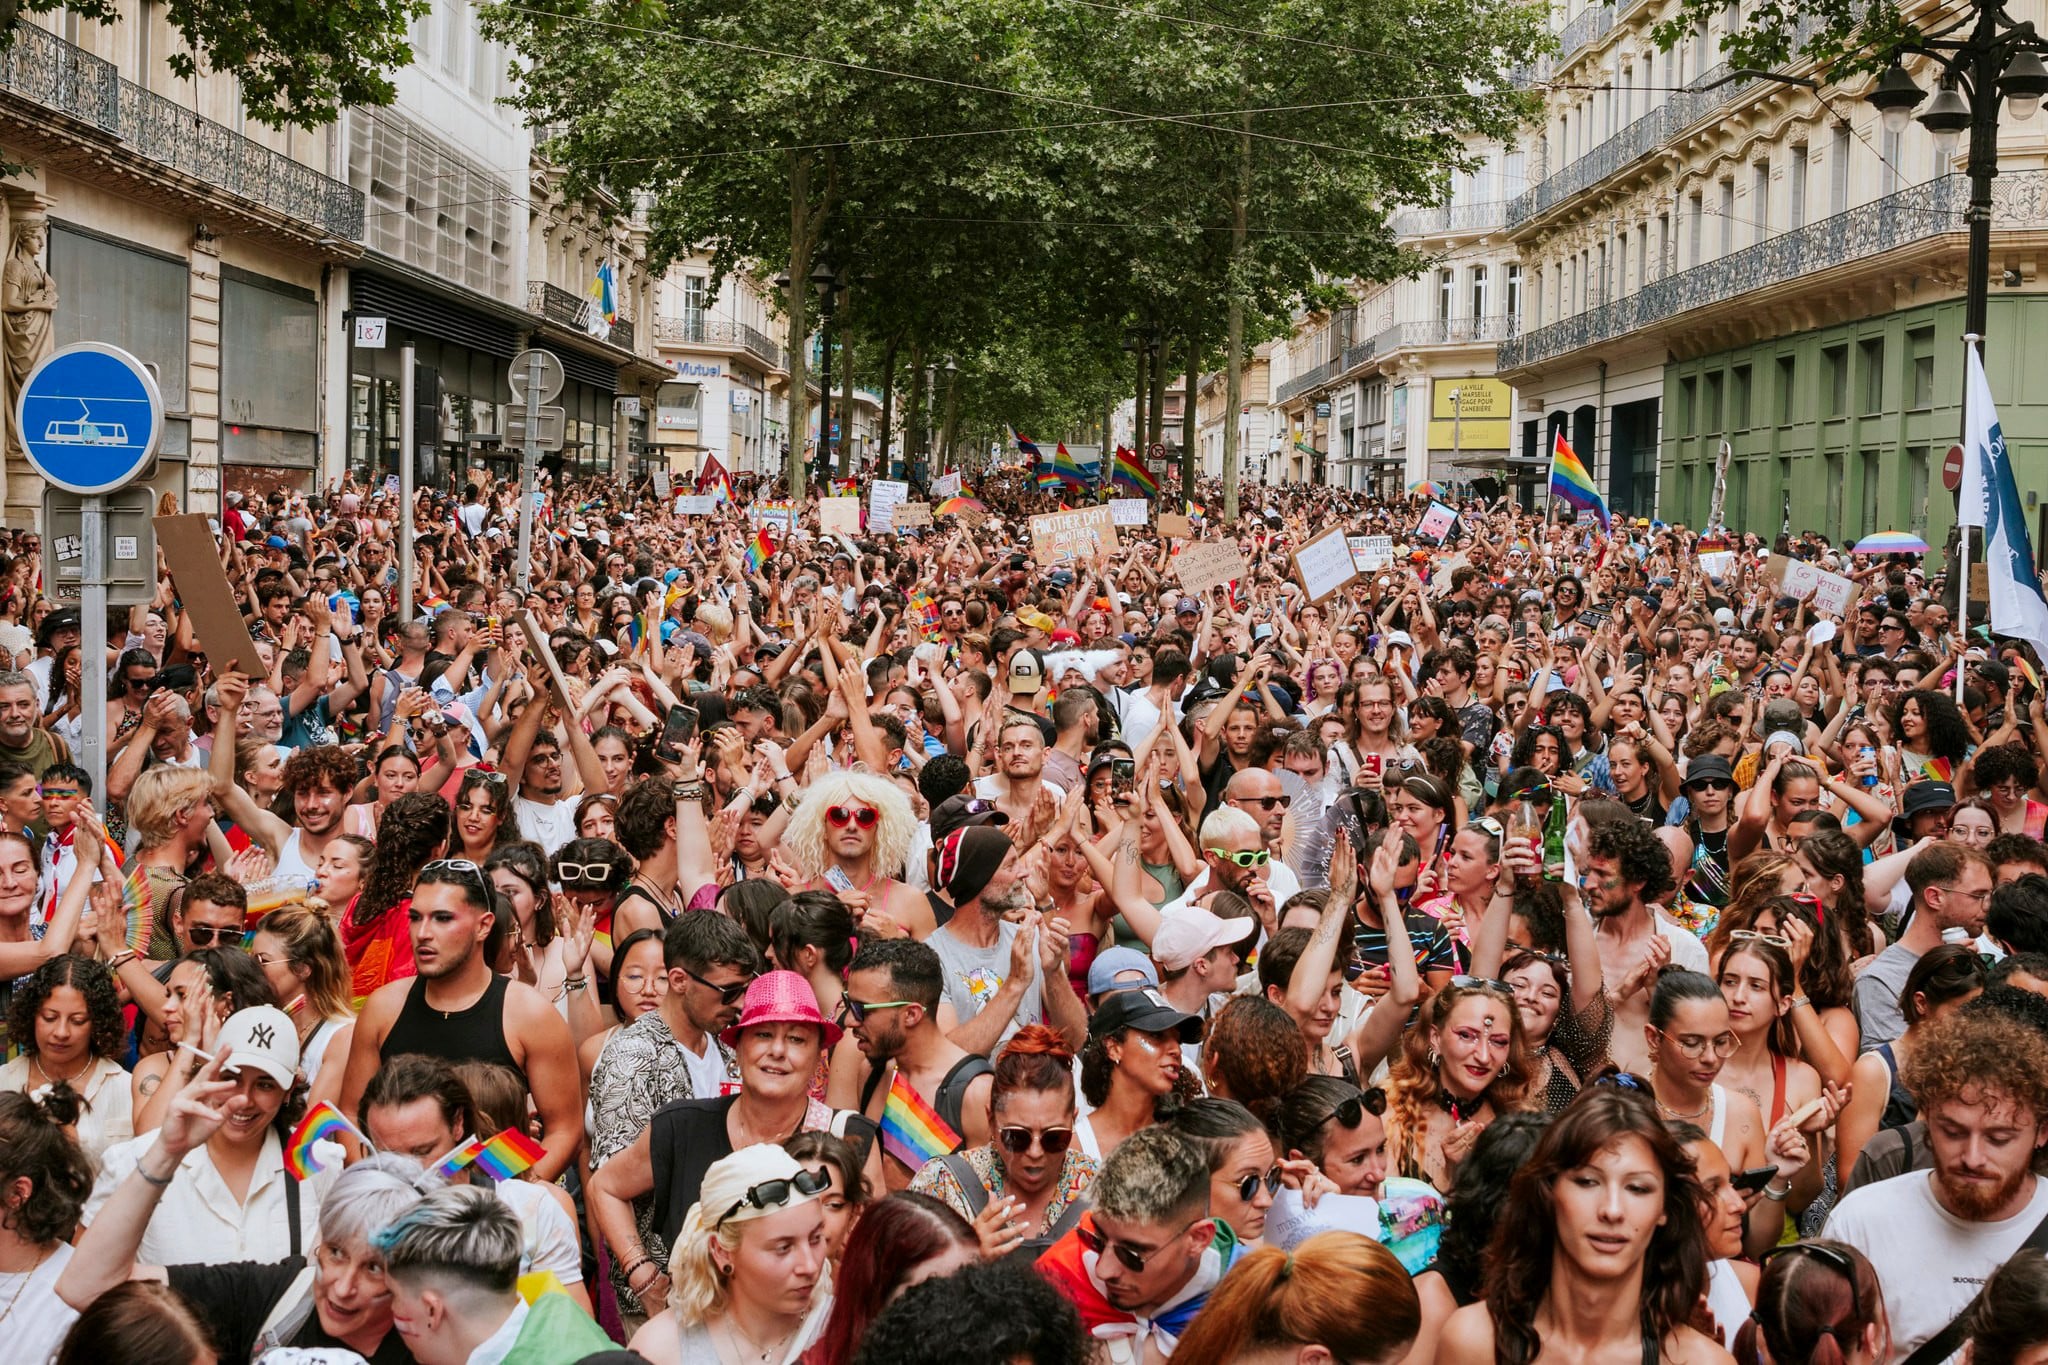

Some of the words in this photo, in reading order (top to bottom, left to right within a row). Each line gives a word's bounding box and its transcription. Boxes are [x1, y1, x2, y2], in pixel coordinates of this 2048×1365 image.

[358, 324, 384, 340] 1&7
[677, 361, 721, 378] Mutuel
[1468, 383, 1484, 391] VILLE
[672, 415, 698, 425] Mutuel
[1033, 513, 1081, 536] ANOTHER
[1082, 507, 1109, 527] DAY
[1056, 526, 1093, 545] ANOTHER
[1360, 537, 1392, 548] MATTER
[1178, 555, 1197, 568] SEX
[1202, 550, 1212, 559] IS
[1212, 543, 1236, 556] COOL
[247, 1022, 276, 1050] NY
